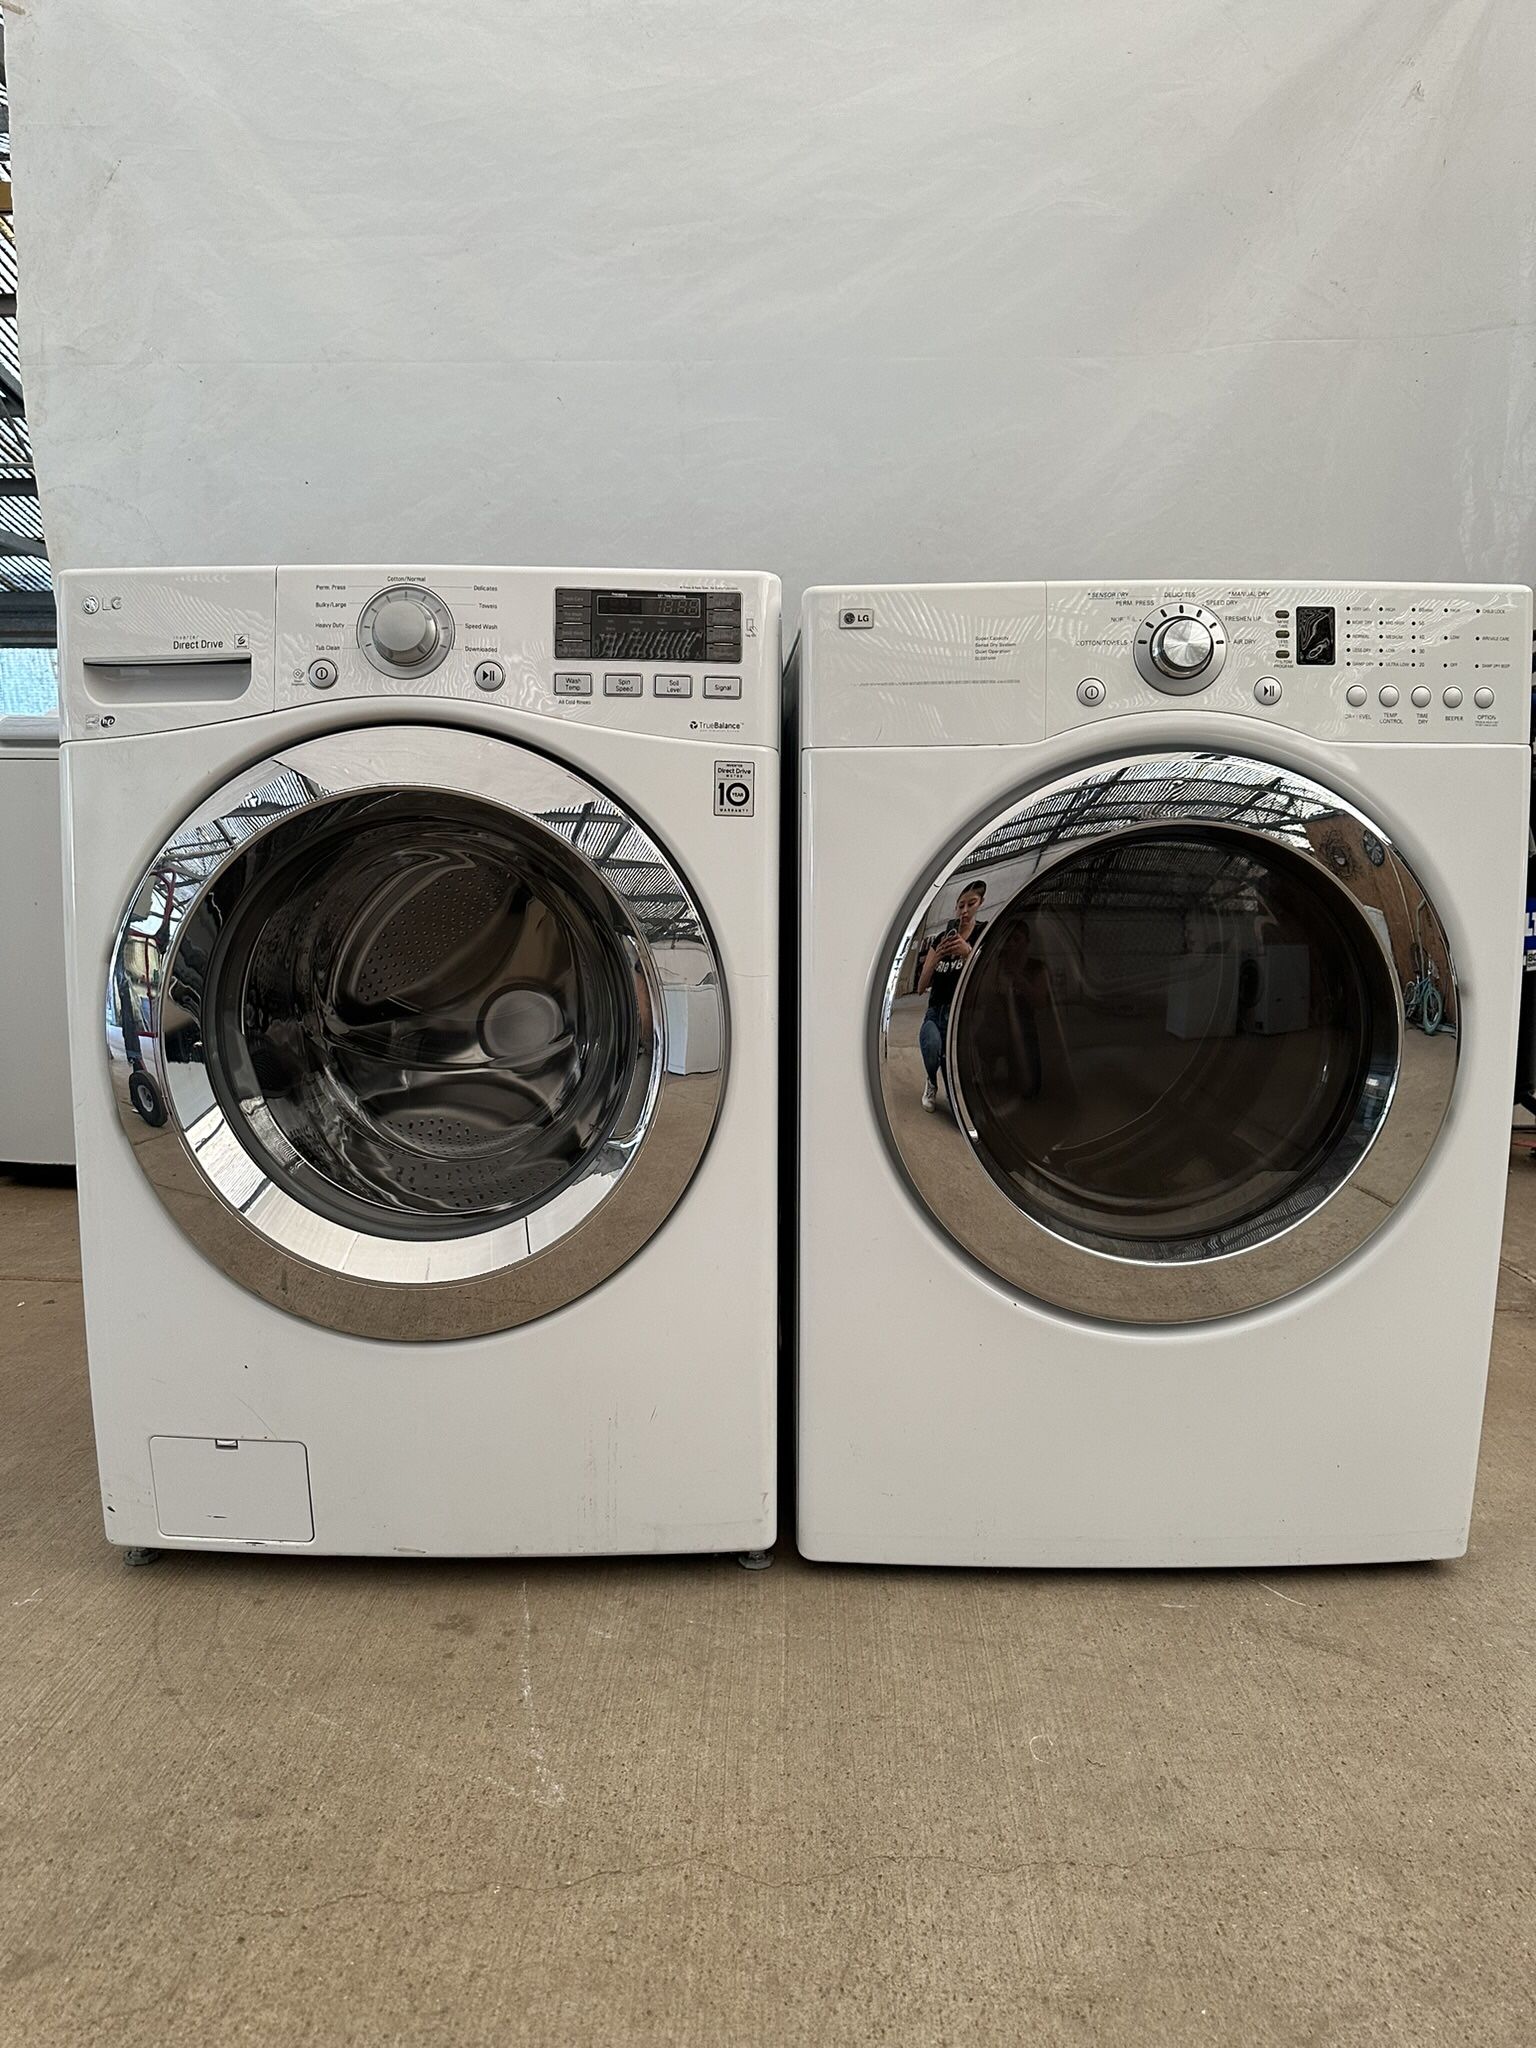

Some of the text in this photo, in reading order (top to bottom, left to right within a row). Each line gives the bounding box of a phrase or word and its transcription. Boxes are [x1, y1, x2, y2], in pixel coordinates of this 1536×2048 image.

[857, 614, 870, 622] LG
[173, 639, 224, 650] Direct Drive
[714, 684, 732, 692] Signal
[718, 782, 750, 807] 10
